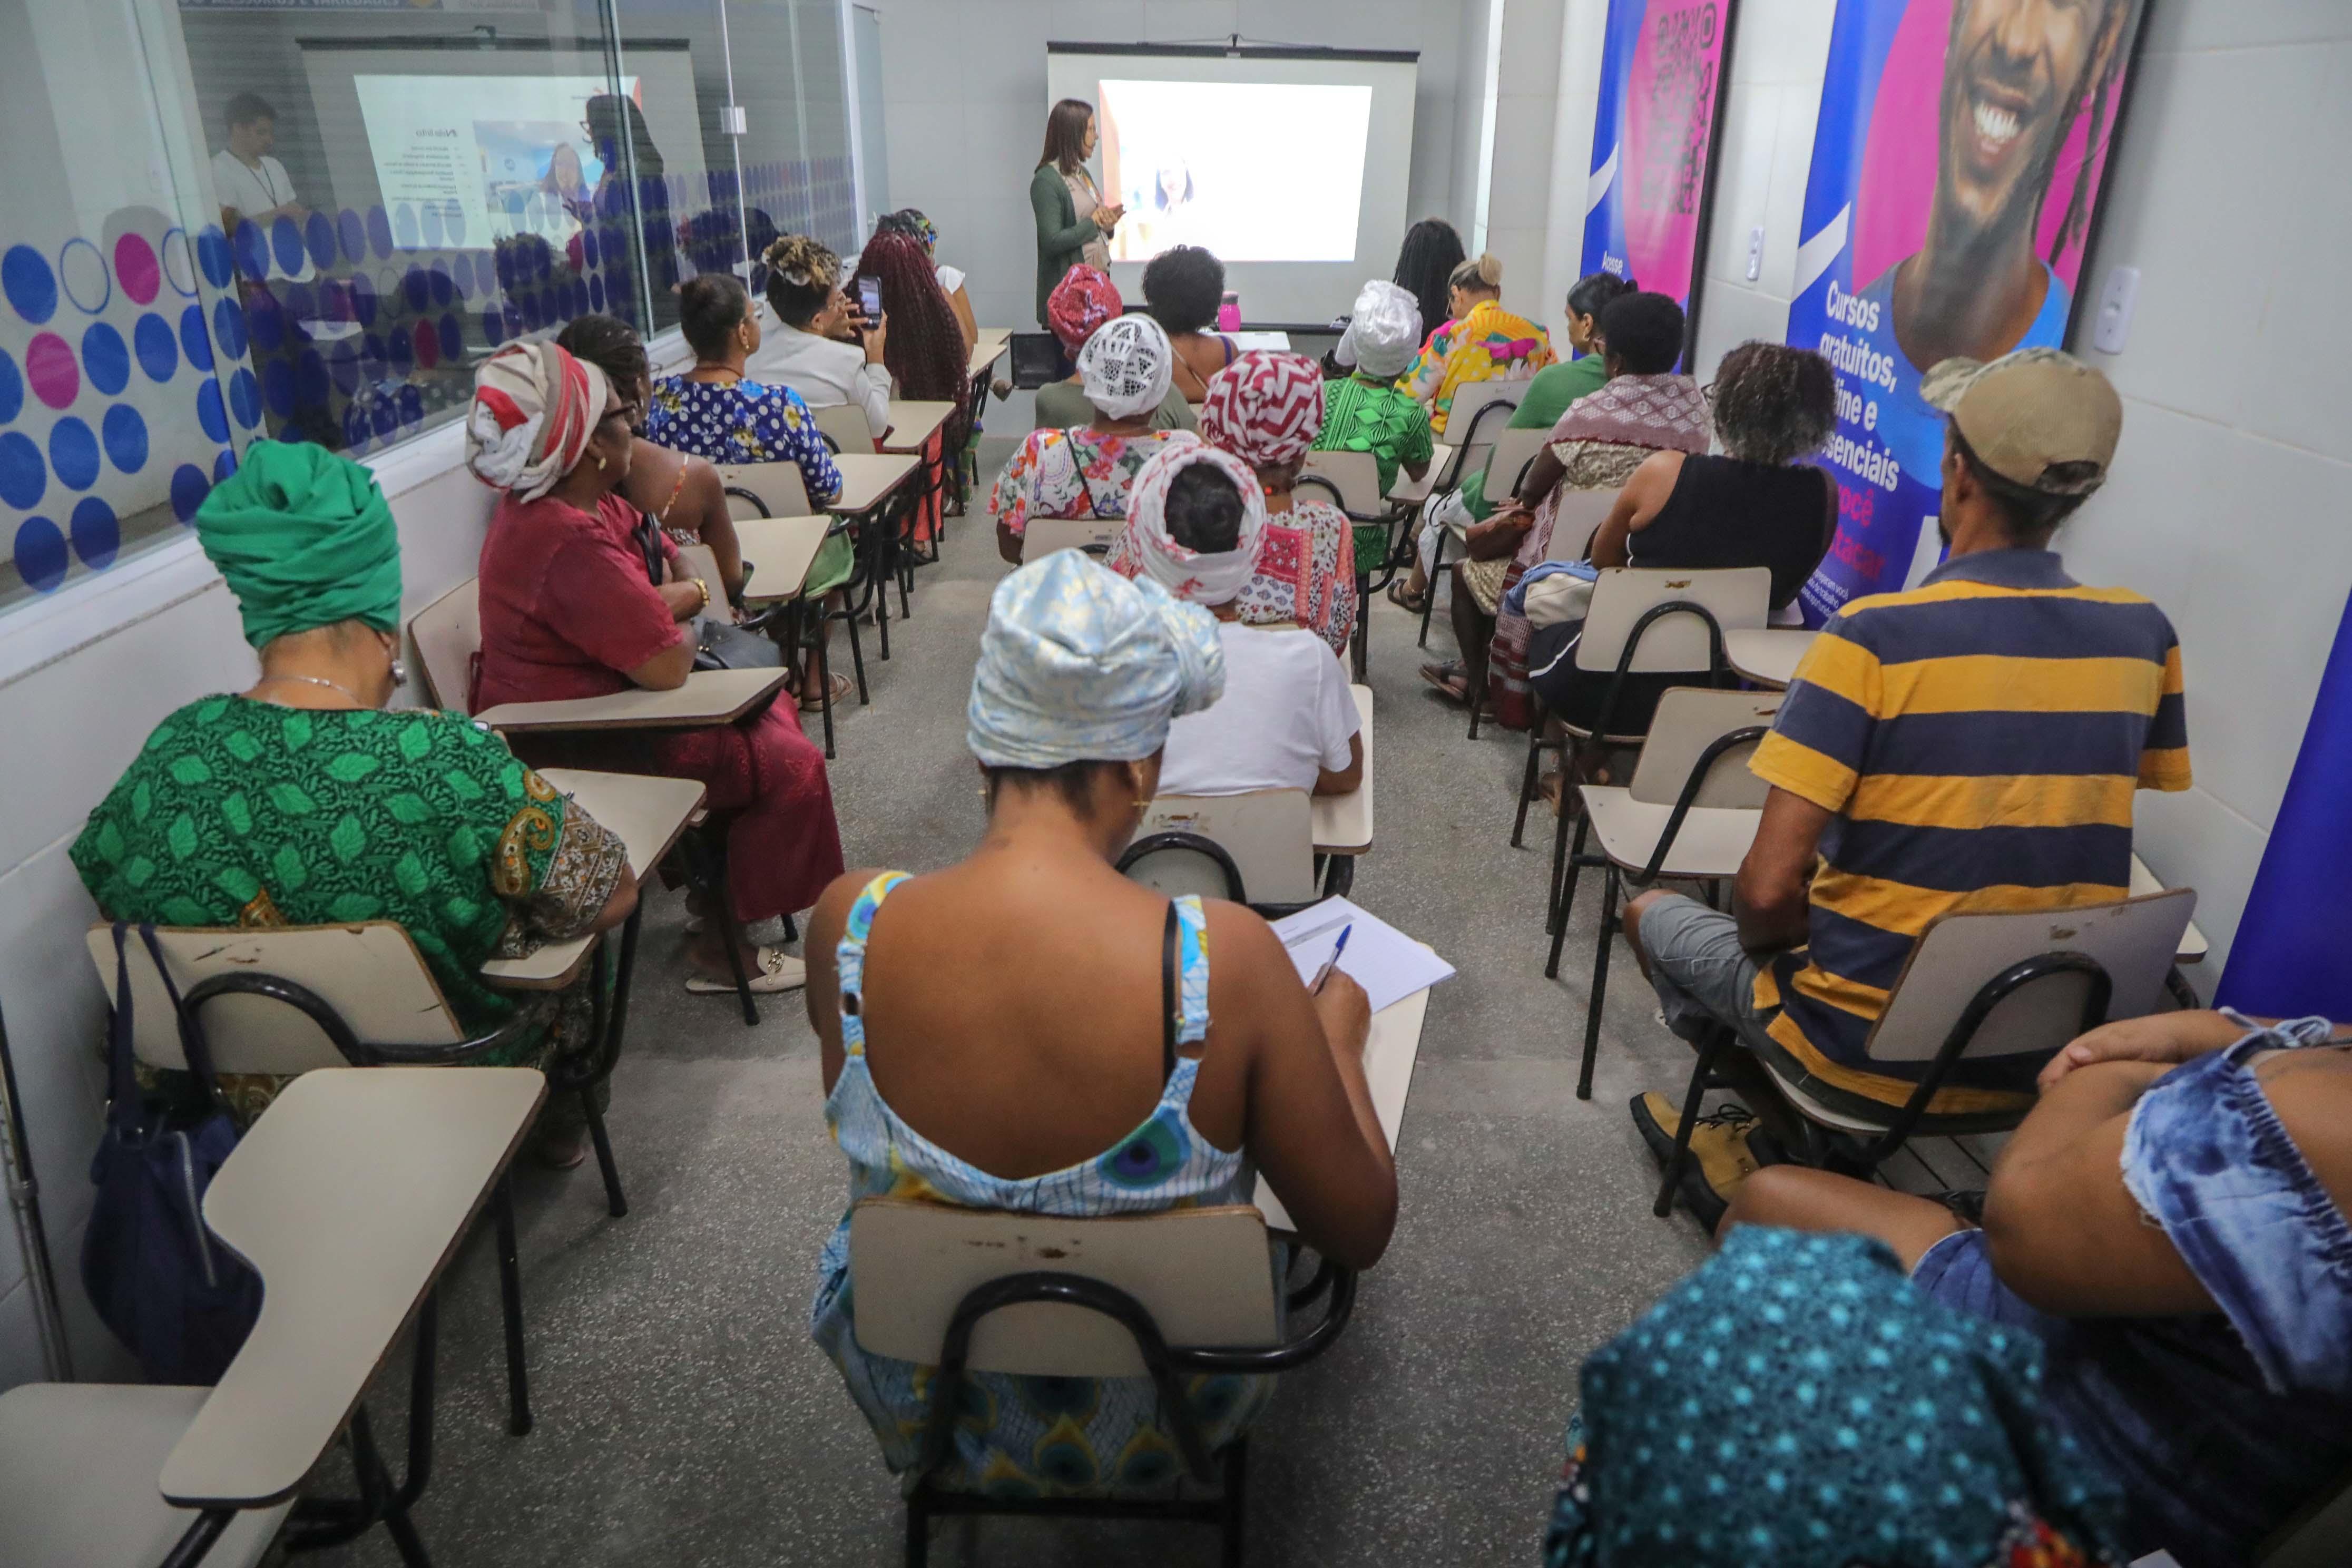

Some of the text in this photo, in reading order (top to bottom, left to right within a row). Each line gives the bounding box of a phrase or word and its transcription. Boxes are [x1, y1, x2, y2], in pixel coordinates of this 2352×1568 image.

[1602, 250, 1623, 275] Acesse
[1827, 280, 1880, 332] Cursos
[1820, 332, 1897, 393] gratuitos,
[1834, 378, 1878, 431] line e
[1822, 432, 1899, 492] senciais
[1838, 484, 1873, 527] ocê
[1830, 526, 1884, 577] tacar
